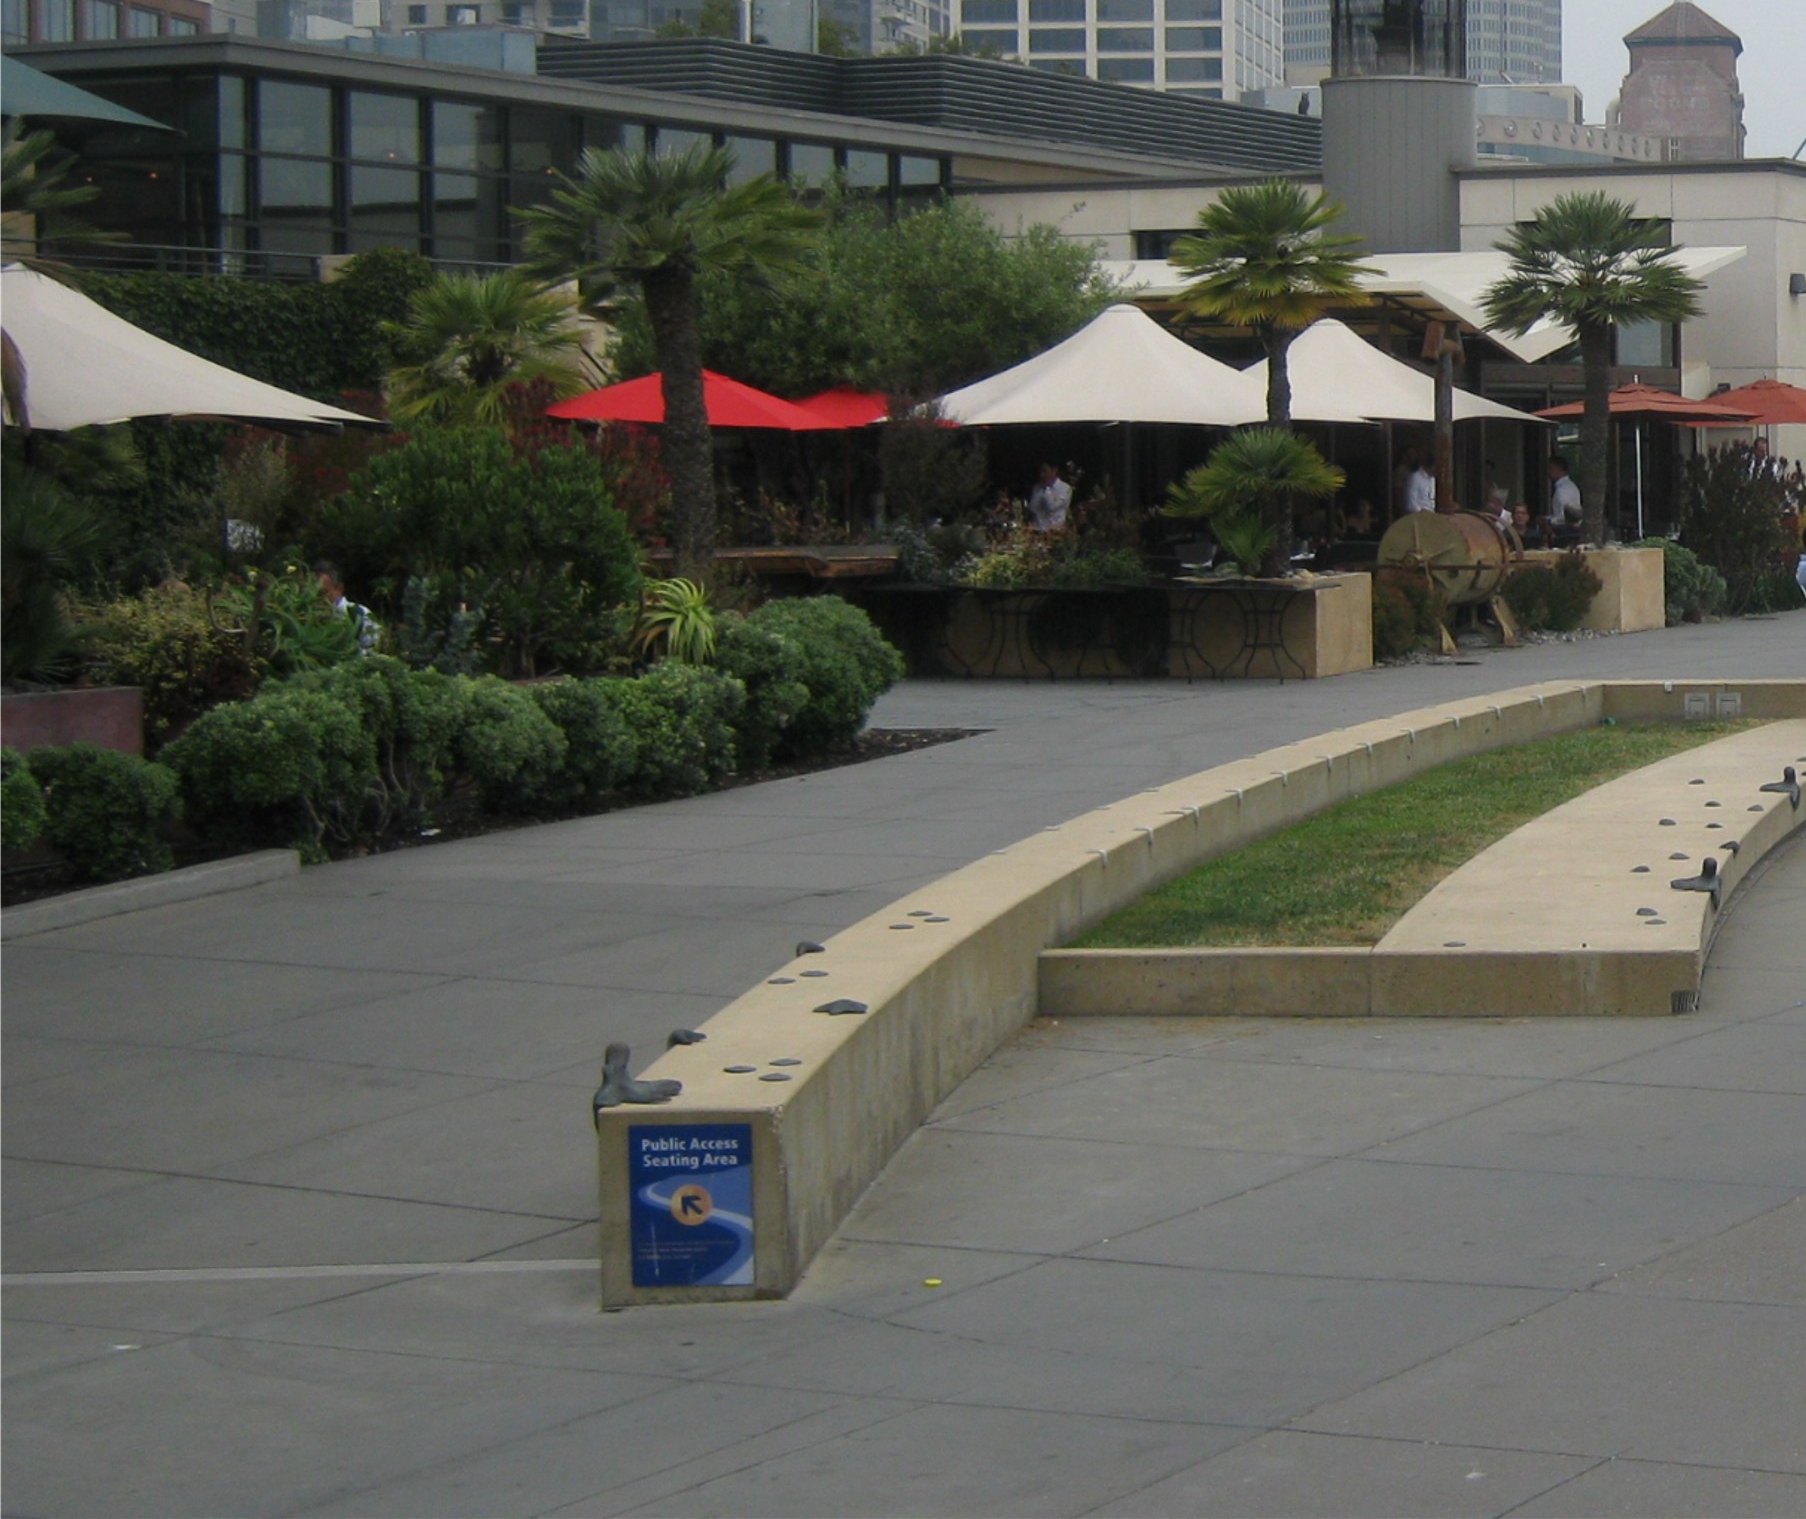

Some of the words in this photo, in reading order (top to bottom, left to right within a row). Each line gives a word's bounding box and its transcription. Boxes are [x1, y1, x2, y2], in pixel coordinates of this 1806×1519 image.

[641, 1137, 687, 1151] Public
[689, 1137, 739, 1150] Access
[643, 1153, 700, 1169] Seating
[702, 1153, 738, 1166] Area
